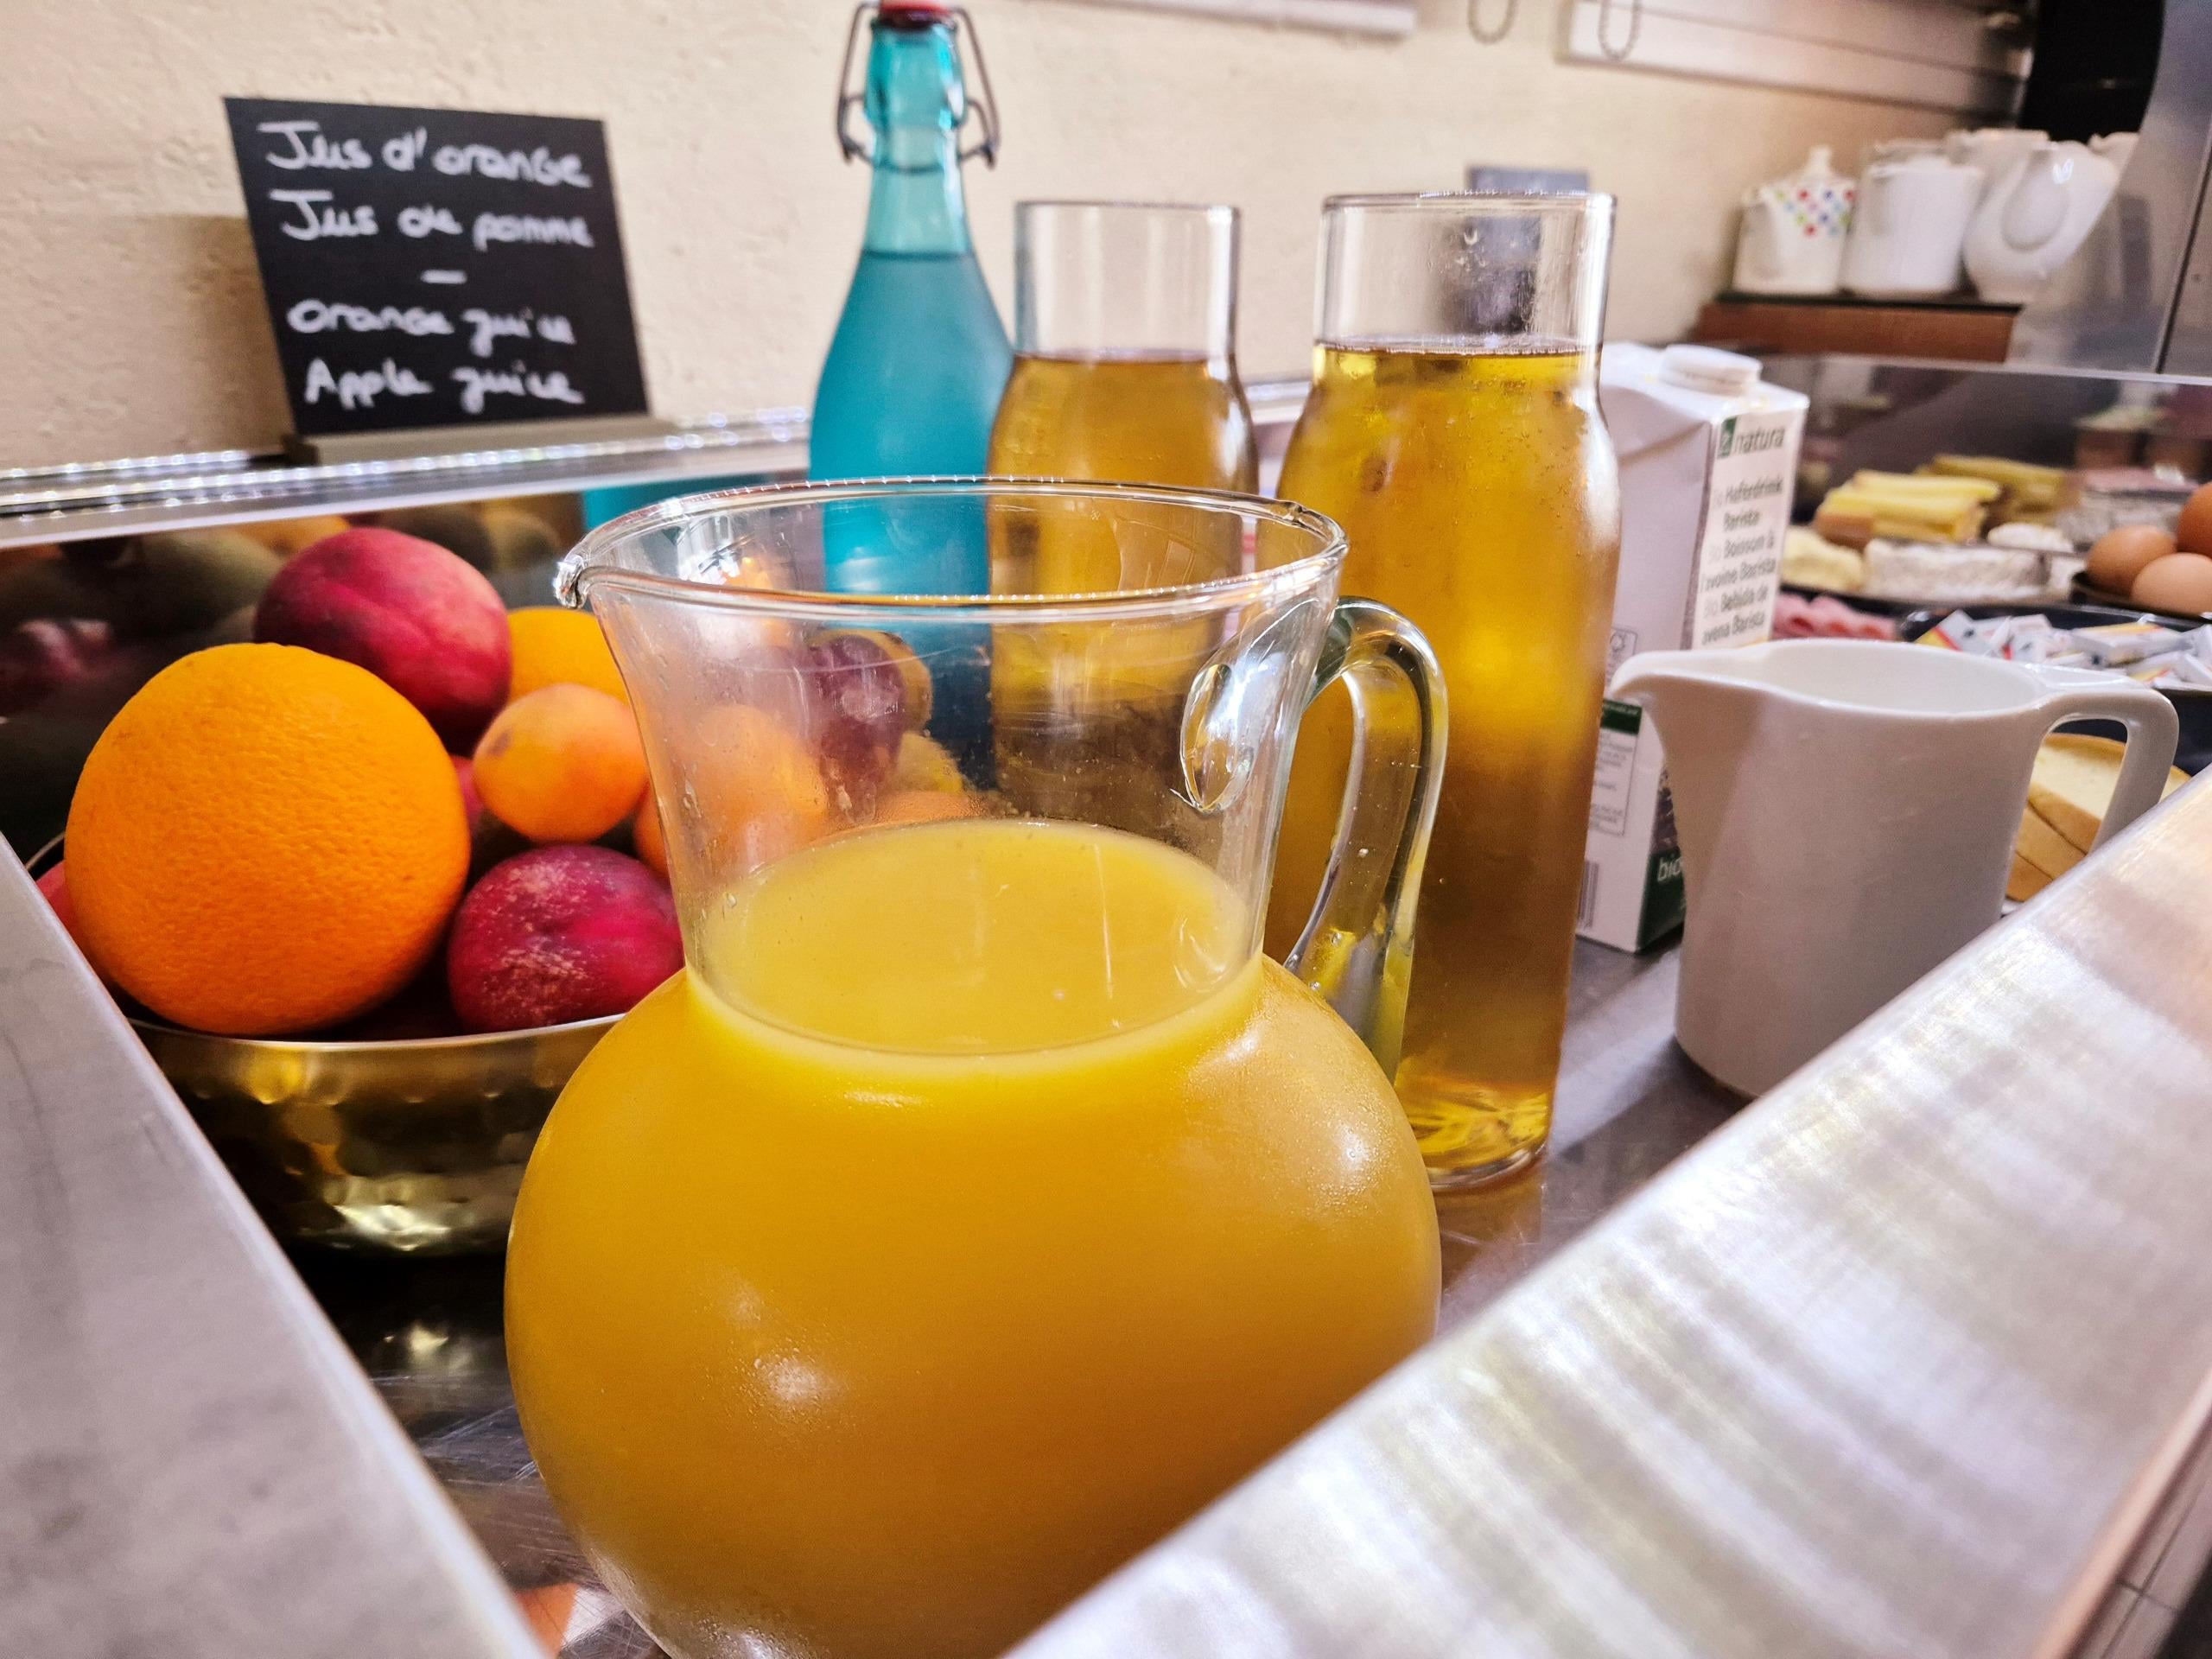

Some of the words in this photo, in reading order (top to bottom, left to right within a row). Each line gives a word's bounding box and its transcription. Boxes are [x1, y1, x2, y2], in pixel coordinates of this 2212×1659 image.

[258, 121, 372, 170] Jus
[269, 189, 378, 241] Jus
[398, 205, 463, 238] de
[473, 213, 594, 251] pomme
[462, 307, 575, 358] juice
[305, 358, 433, 410] Apple
[450, 360, 584, 413] juice
